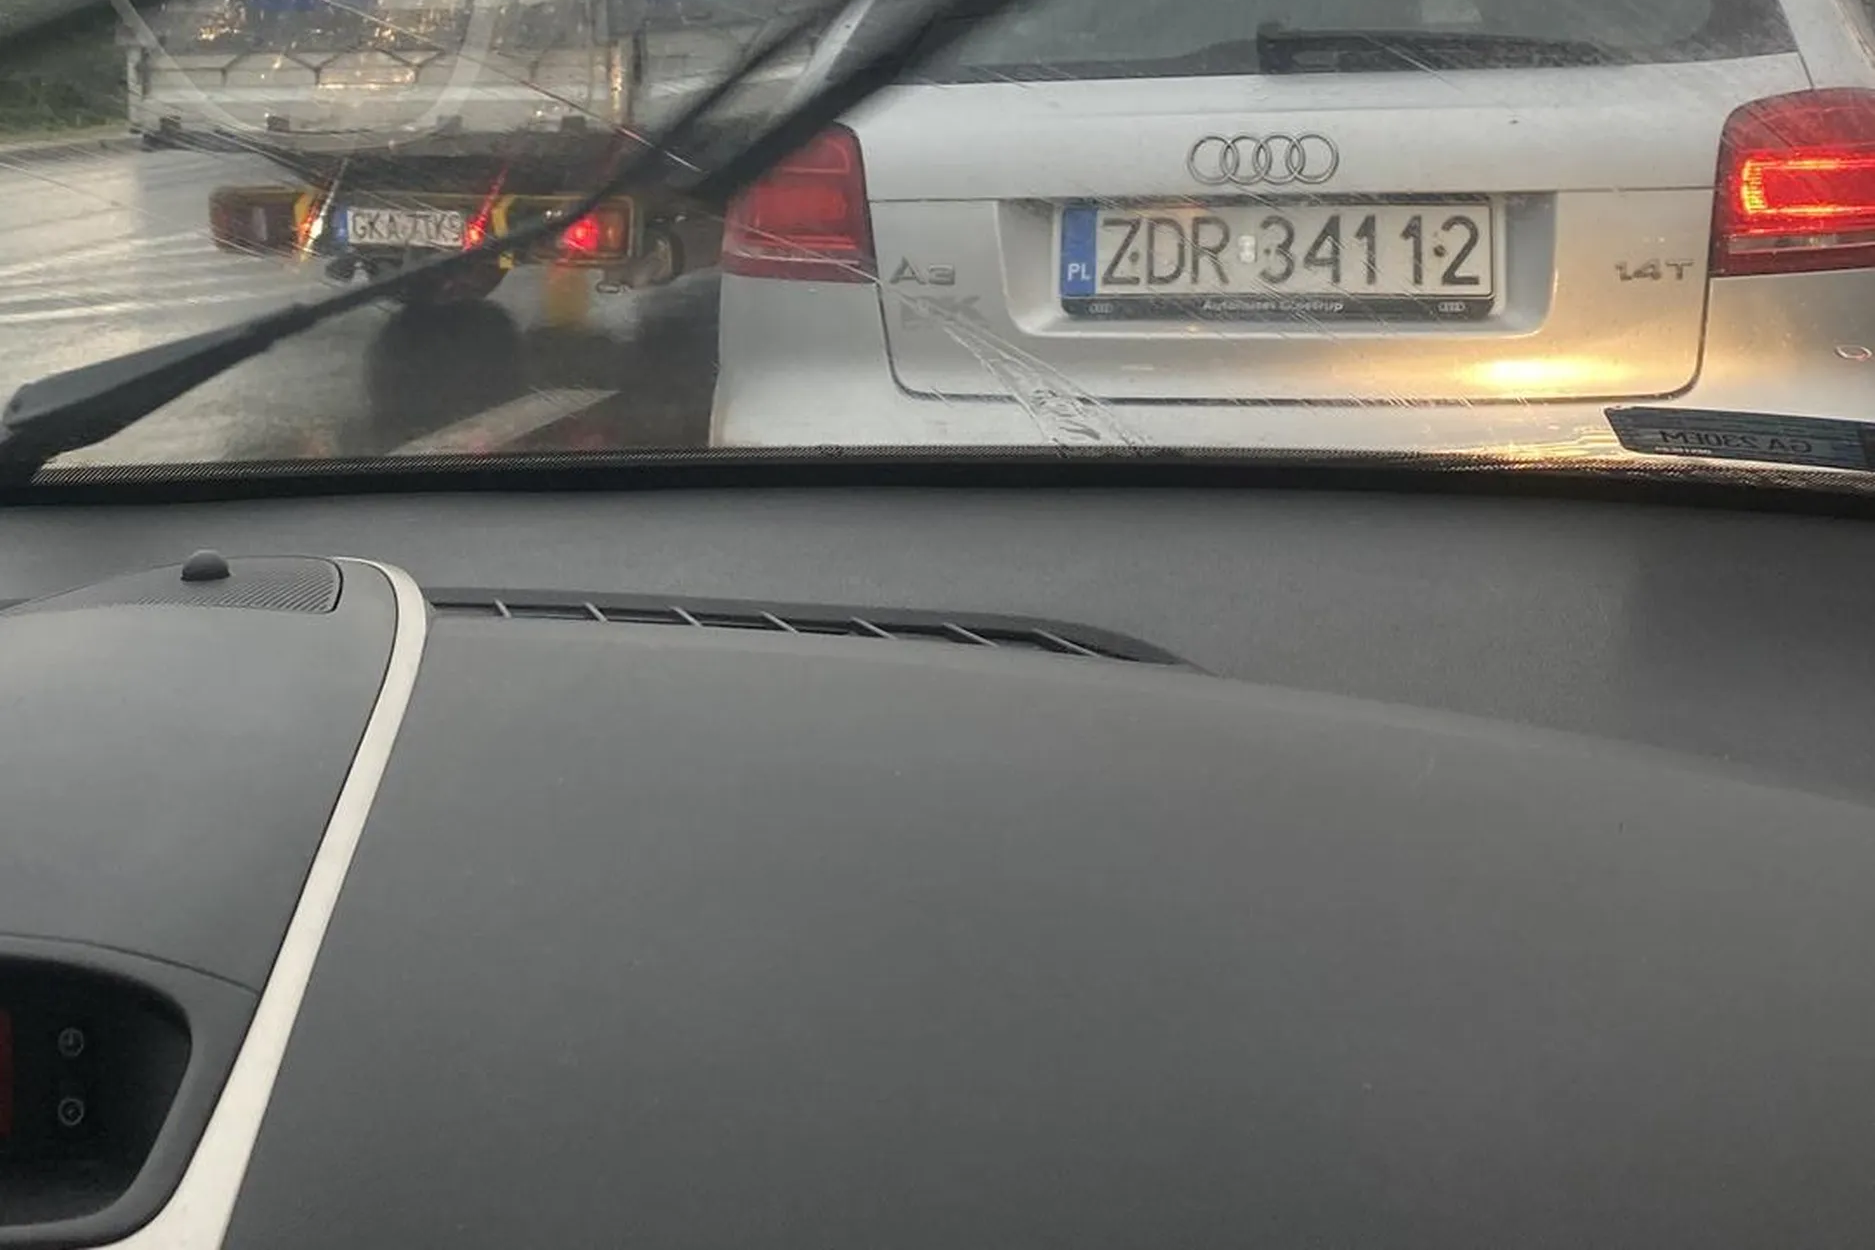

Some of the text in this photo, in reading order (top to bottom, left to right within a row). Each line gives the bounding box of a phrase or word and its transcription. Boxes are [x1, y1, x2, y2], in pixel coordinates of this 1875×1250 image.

[1101, 214, 1480, 286] ZDR 34112
[888, 255, 956, 286] A3
[1067, 263, 1091, 281] PL
